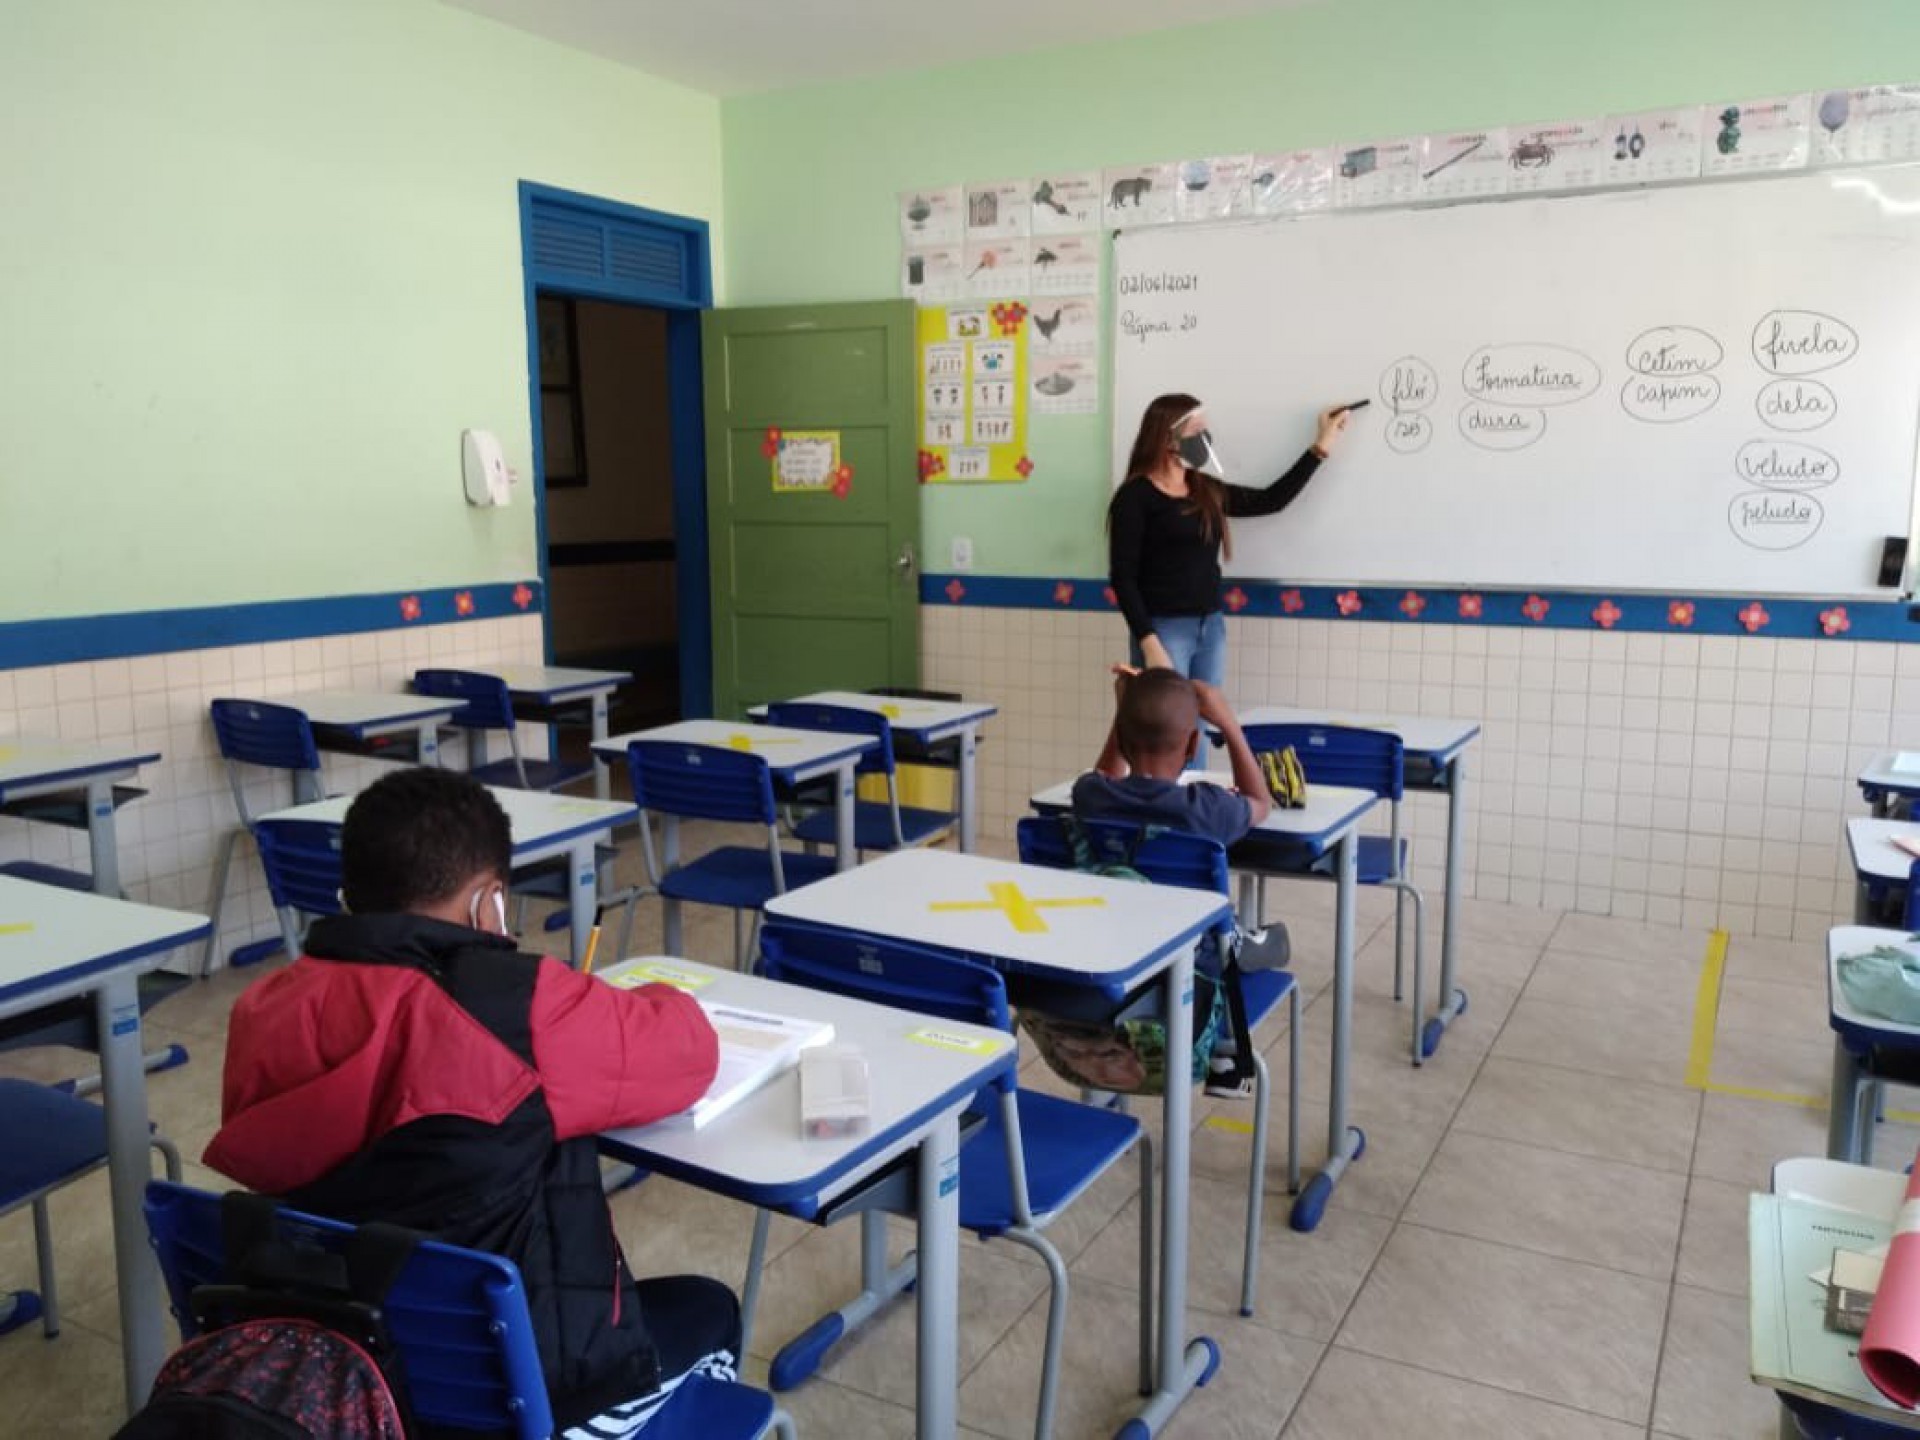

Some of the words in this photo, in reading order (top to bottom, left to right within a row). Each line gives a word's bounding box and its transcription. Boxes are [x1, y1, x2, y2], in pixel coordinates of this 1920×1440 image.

[1120, 272, 1197, 294] 02/06/2021
[1760, 319, 1848, 369] fivela
[1766, 384, 1828, 414] dela
[1469, 408, 1530, 430] dura
[1741, 496, 1812, 526] peludo
